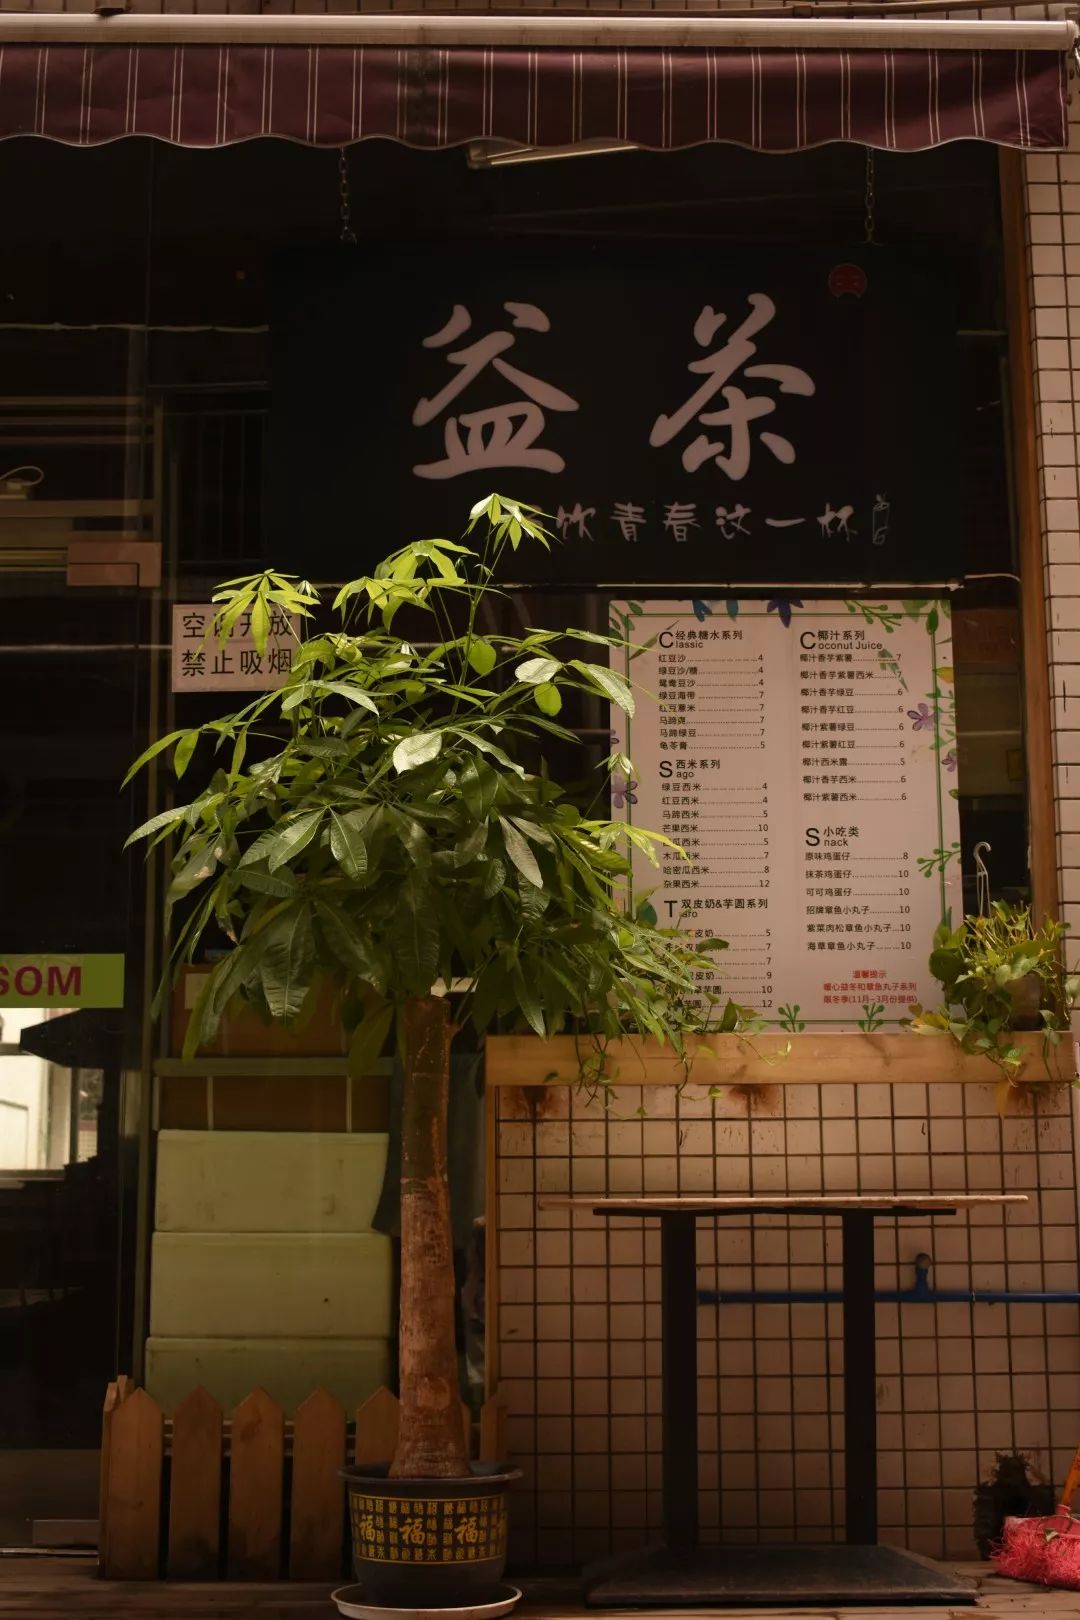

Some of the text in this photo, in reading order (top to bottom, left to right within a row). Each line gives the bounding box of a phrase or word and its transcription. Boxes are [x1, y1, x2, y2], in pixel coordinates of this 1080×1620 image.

[675, 630, 743, 640] 经典糖水系列
[817, 630, 865, 640] 椰汁系列
[855, 641, 883, 650] Juice
[659, 654, 686, 663] 红豆沙
[800, 653, 852, 662] 椰汁香芋紫薯
[181, 649, 292, 677] 禁止吸烟
[800, 671, 874, 680] 椰汁香芋紫薯西米
[659, 679, 696, 688] 鸳鸯豆沙
[659, 691, 695, 700] 绿豆海带
[801, 688, 854, 697] 椰汁香芋绿豆
[801, 705, 854, 714] 椰汁香芋红豆
[801, 722, 855, 731] 椰汁紫薯绿豆
[660, 729, 697, 738] 马蹄绿豆
[660, 741, 688, 750] 龟苓膏
[802, 740, 855, 749] 椰汁紫薯红豆
[676, 759, 720, 769] 西米系列
[802, 758, 847, 766] 椰汁西米露
[803, 775, 857, 784] 椰汁香芋西米
[661, 782, 702, 791] 绿豆西米
[661, 796, 699, 805] 红豆西米
[803, 793, 857, 801] 椰汁紫薯西米
[662, 810, 699, 819] 马蹄西米
[662, 824, 769, 833] 芒果西米 10
[823, 826, 859, 837] 小吃类
[805, 852, 850, 861] 原味鸡蛋仔
[663, 866, 710, 875] 哈密瓜西米
[805, 870, 909, 879] 抹茶鸡蛋仔 10
[663, 880, 770, 888] 杂果西米 12
[806, 888, 910, 897] 可可鸡蛋仔 10
[806, 906, 910, 915] 招牌章鱼小丸子 10
[807, 924, 911, 933] 紫菜肉松章鱼小丸子 10
[901, 942, 912, 950] 10
[761, 986, 773, 994] 10
[761, 1000, 773, 1008] 12
[400, 1517, 426, 1545] 福
[454, 1516, 479, 1545] 福
